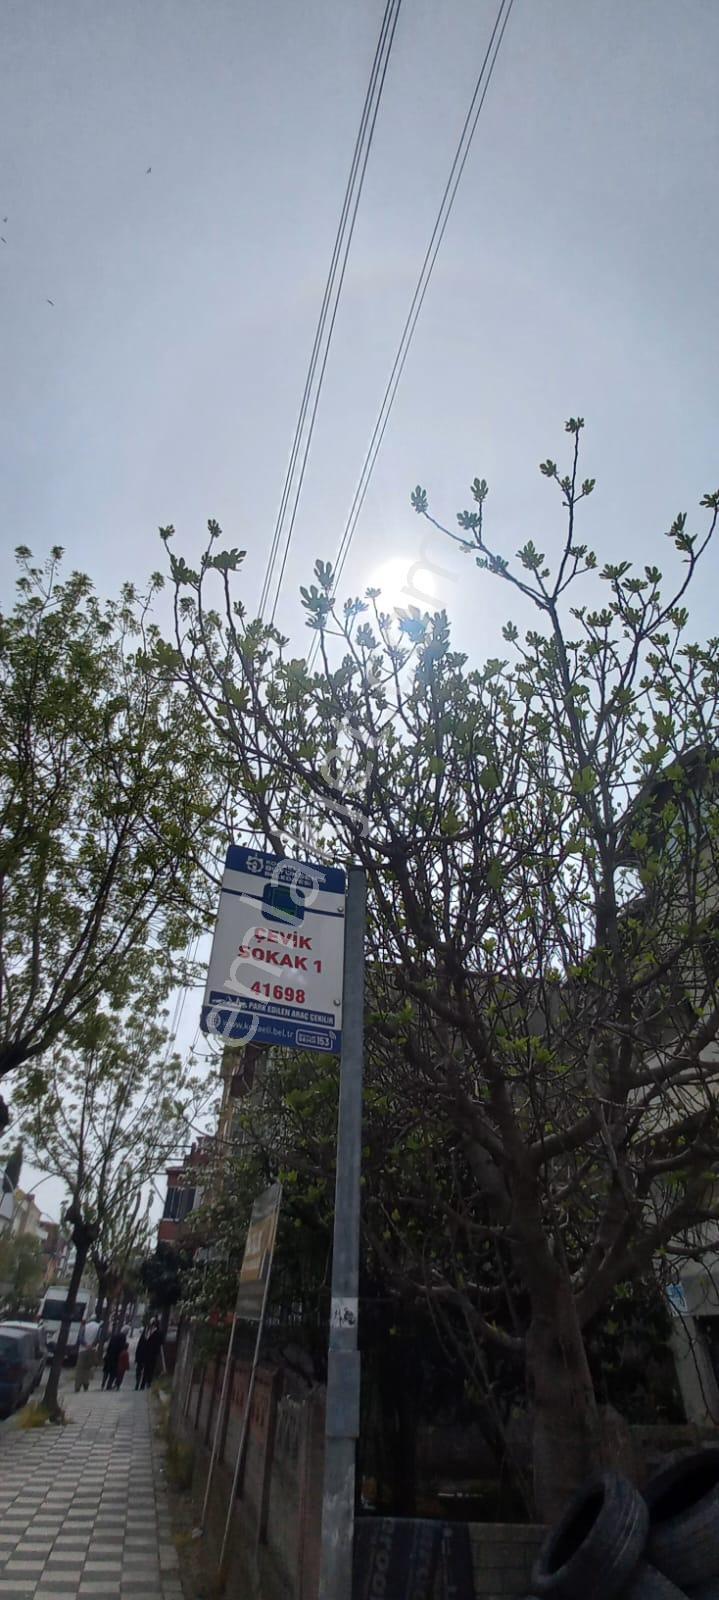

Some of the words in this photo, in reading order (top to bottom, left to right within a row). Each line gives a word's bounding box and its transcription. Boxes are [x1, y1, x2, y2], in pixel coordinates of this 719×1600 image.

[254, 927, 313, 950] ÇEVİK
[238, 945, 308, 971] SOKAK
[313, 960, 322, 973] 1
[250, 981, 305, 1004] 41698
